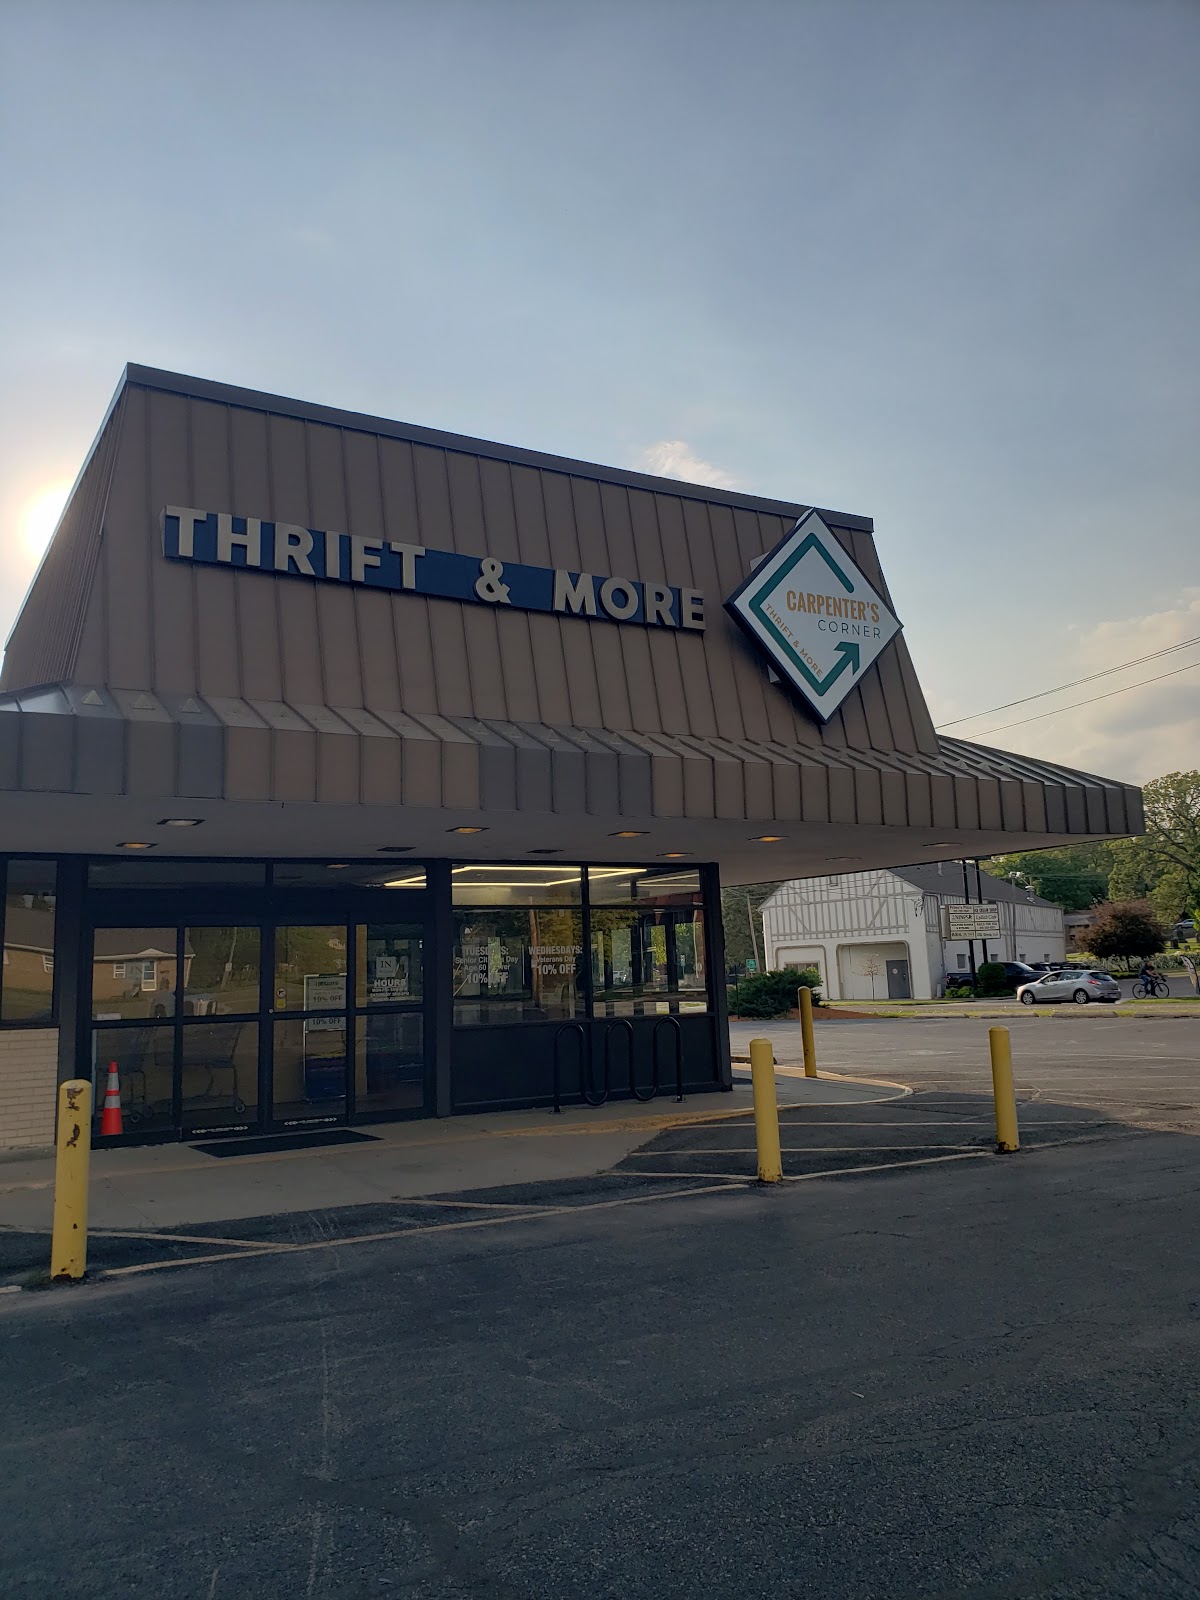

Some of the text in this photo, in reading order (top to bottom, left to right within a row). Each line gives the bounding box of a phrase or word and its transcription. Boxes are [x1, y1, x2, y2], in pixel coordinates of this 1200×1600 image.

[164, 505, 706, 631] THRIFT & MORE
[786, 589, 880, 624] CARPENTER'S
[817, 619, 881, 639] CORNER
[765, 603, 824, 678] THRIFT & MORE
[465, 945, 509, 956] TUESS:
[528, 945, 583, 955] WEDNESDAYS:
[380, 960, 392, 968] IN
[455, 956, 477, 964] Senior
[506, 955, 519, 965] Day
[564, 955, 577, 964] Day
[537, 963, 577, 975] 10% OFF
[374, 978, 406, 987] HOURS
[466, 972, 488, 984] 10%
[328, 1017, 341, 1025] OFF
